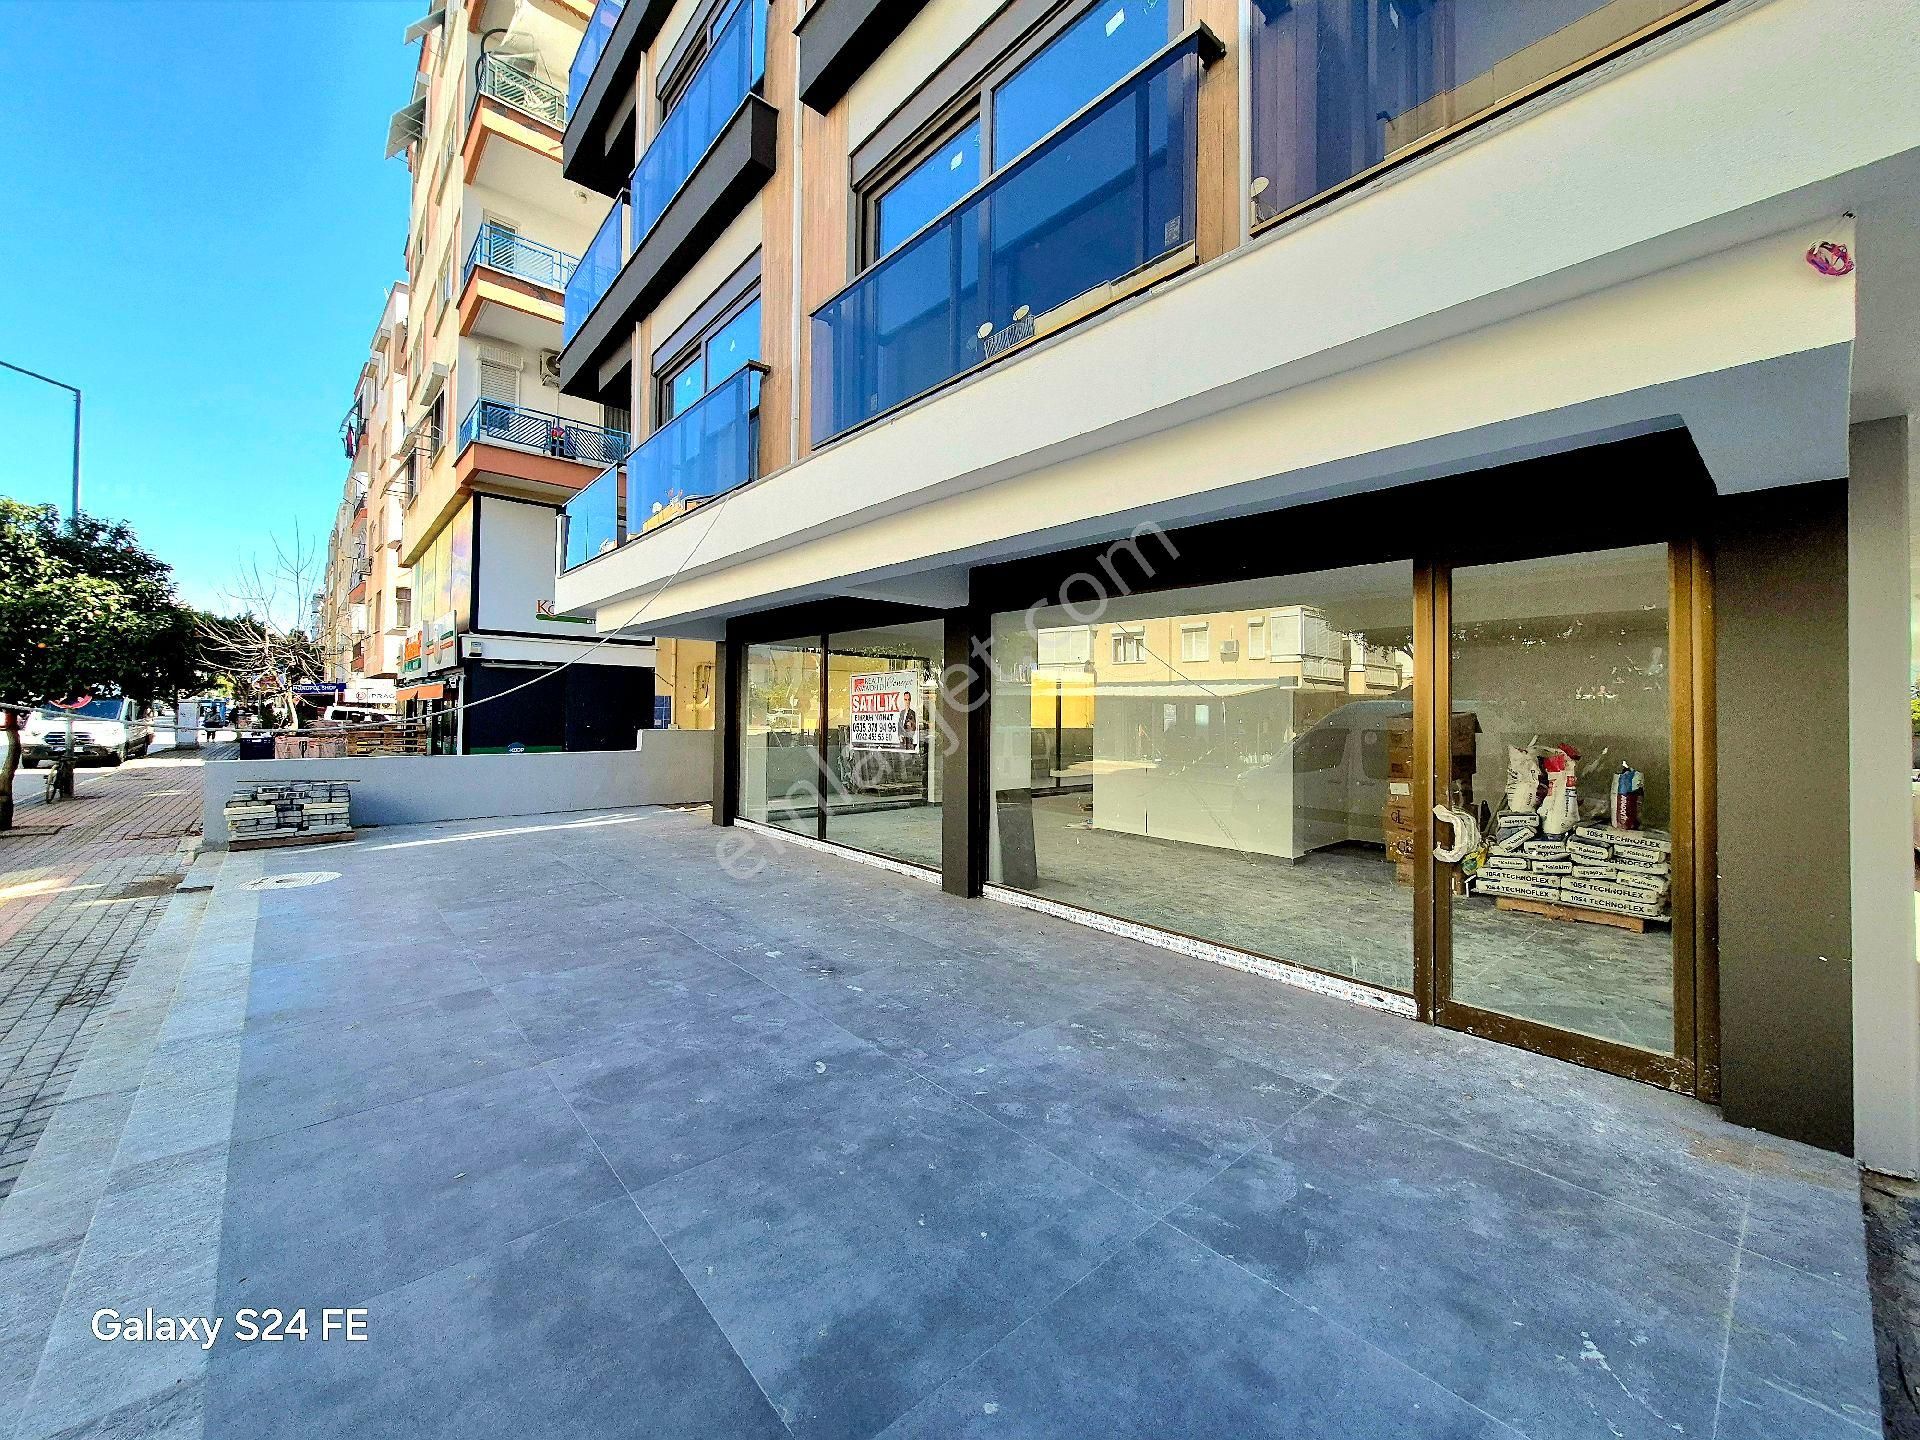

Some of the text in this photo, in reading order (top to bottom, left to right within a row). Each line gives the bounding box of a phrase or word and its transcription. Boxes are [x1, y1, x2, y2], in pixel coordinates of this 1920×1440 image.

[852, 693, 898, 712] SATILIK
[1606, 833, 1661, 848] TECHNOFLEX
[1588, 884, 1644, 899] TECHNOFLEX
[1589, 898, 1645, 913] TECHNOFLEX
